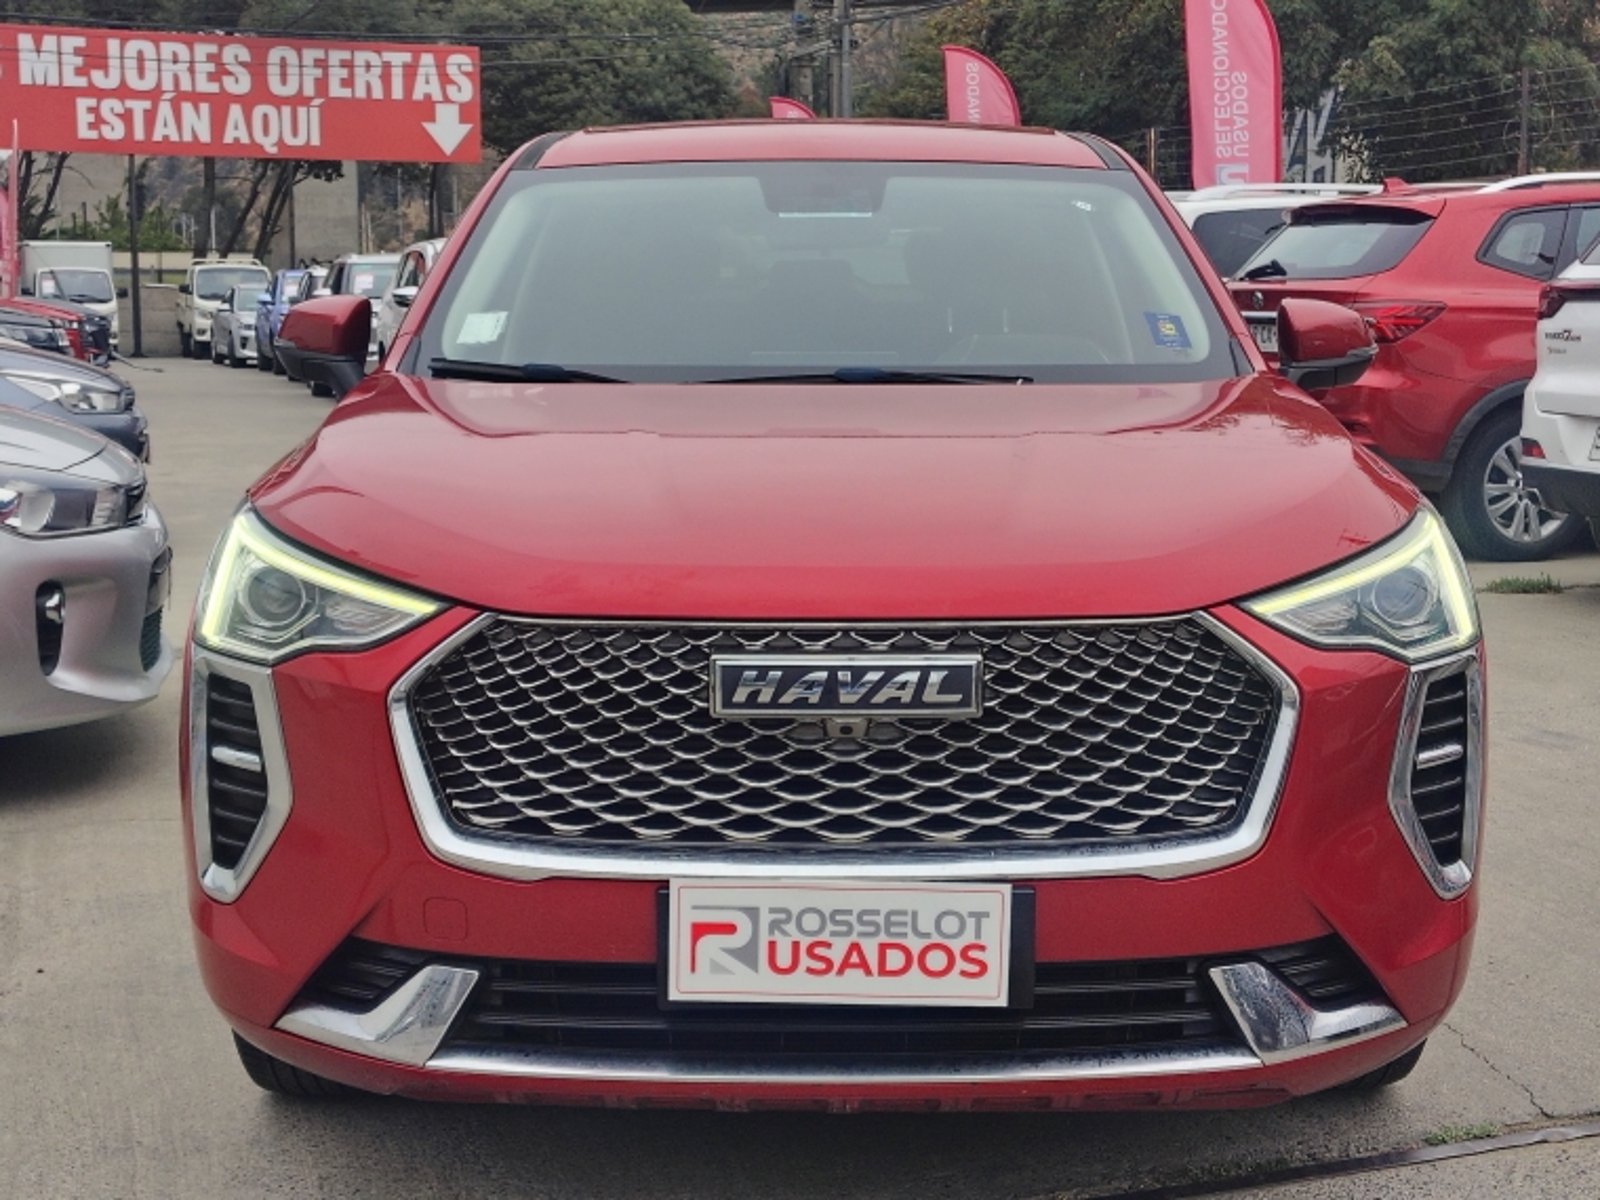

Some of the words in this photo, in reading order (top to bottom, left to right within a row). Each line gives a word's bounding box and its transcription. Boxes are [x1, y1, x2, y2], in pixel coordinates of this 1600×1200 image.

[17, 33, 251, 96] MEJORES
[266, 45, 474, 103] OFERTAS
[75, 92, 212, 144] ESTÁN
[223, 99, 325, 153] AQUÍ
[732, 670, 963, 704] HAVAL
[768, 906, 991, 940] ROSSELOT
[768, 940, 989, 979] USADOS
